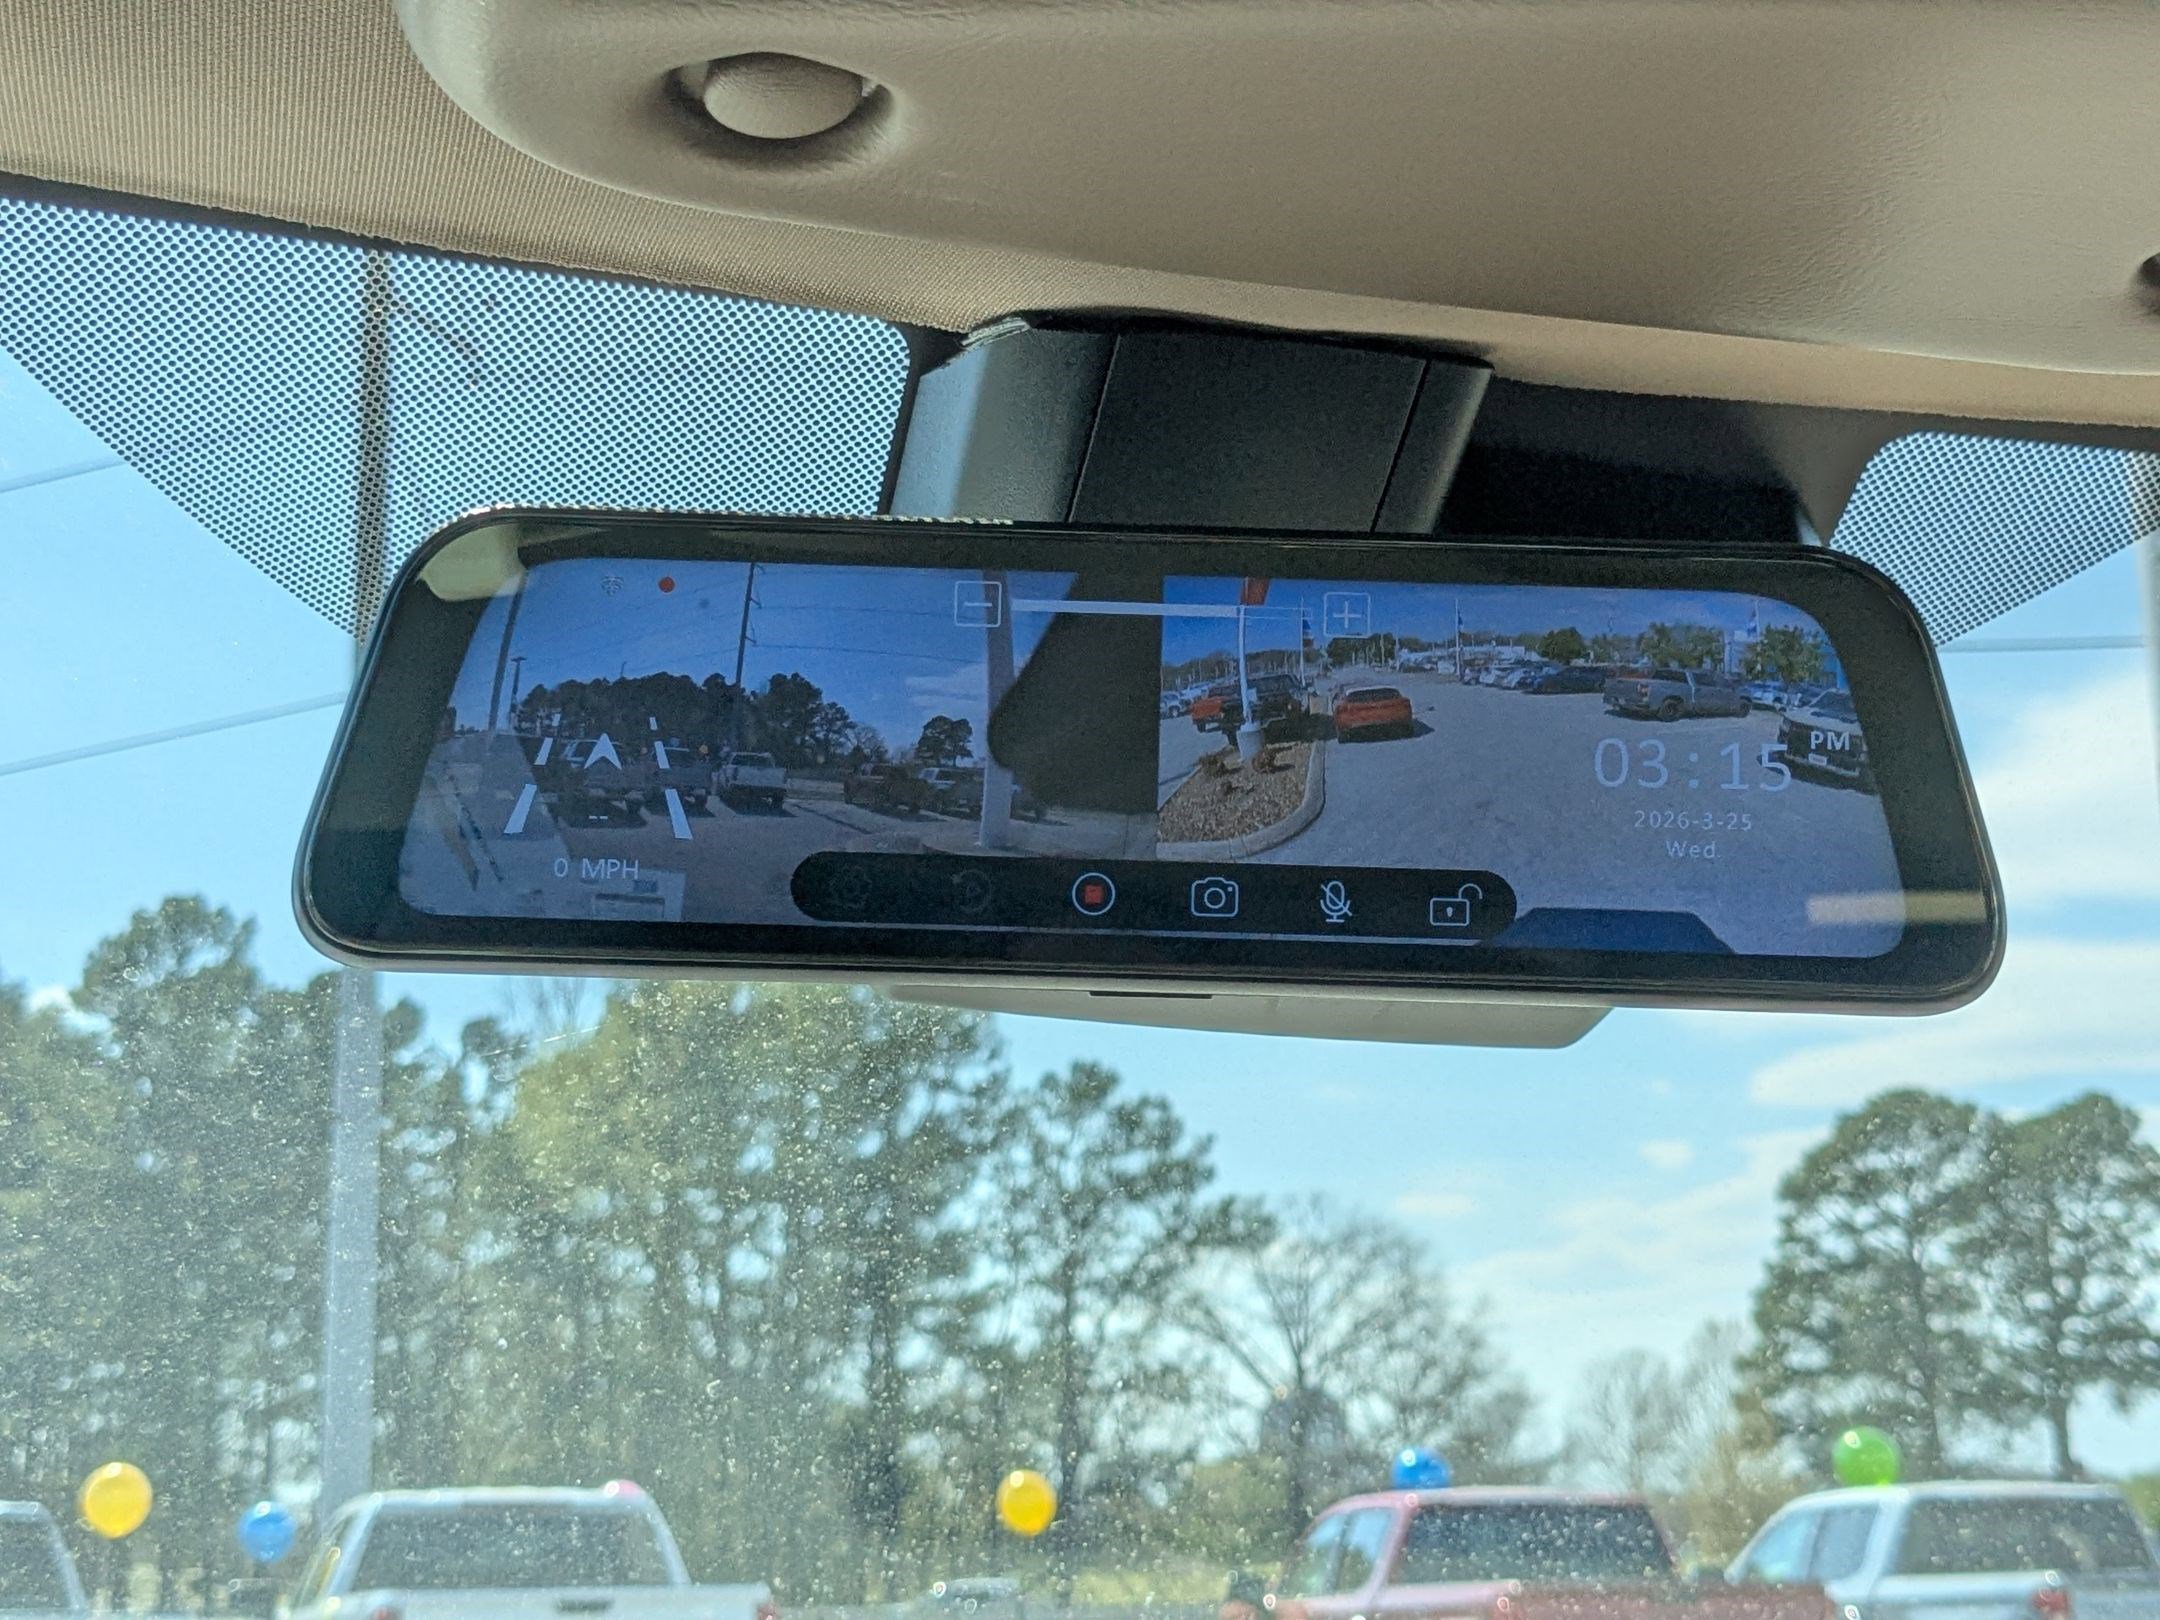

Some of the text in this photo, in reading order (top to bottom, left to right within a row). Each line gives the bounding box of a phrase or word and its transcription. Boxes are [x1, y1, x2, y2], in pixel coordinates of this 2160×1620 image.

[1594, 730, 1850, 792] 03:15 PM
[1633, 809, 1752, 832] 2026-3-25
[553, 857, 639, 880] 0 MPH
